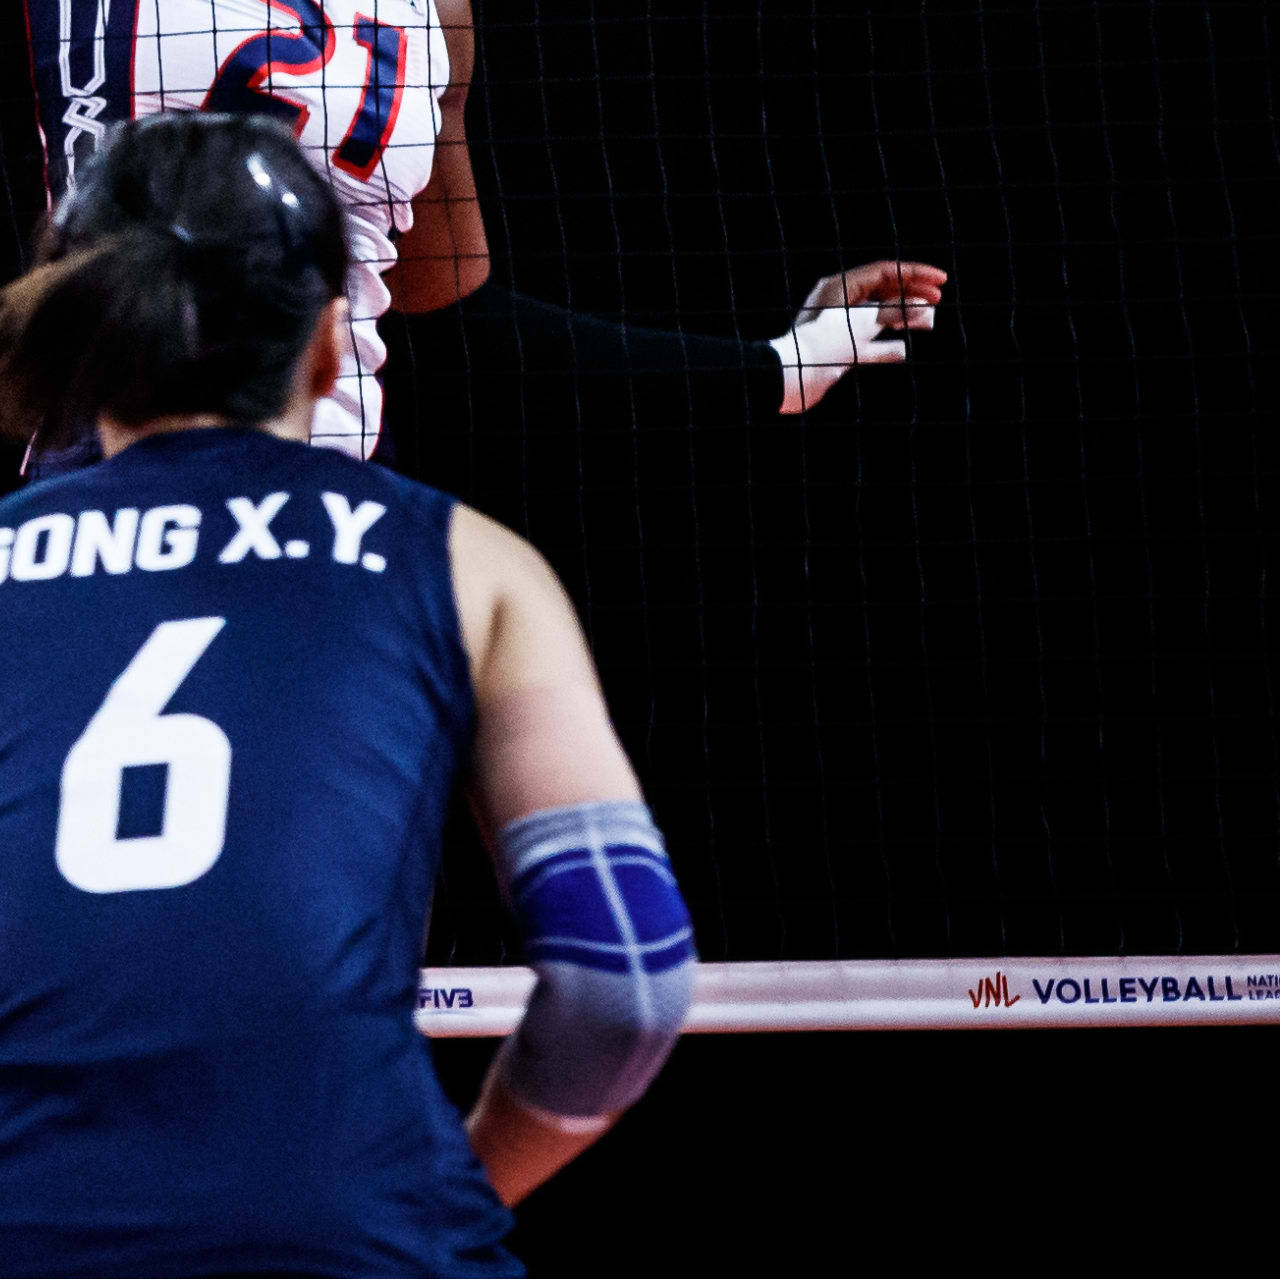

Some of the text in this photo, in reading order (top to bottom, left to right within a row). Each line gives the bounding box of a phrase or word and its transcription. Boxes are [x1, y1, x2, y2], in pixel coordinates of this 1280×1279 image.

[218, 491, 311, 565] X.
[320, 491, 388, 573] Y.
[54, 615, 233, 895] 6
[419, 987, 474, 1009] FIVB
[968, 970, 1243, 1010] VNL VOLLEYBALL
[1246, 975, 1280, 988] NATI
